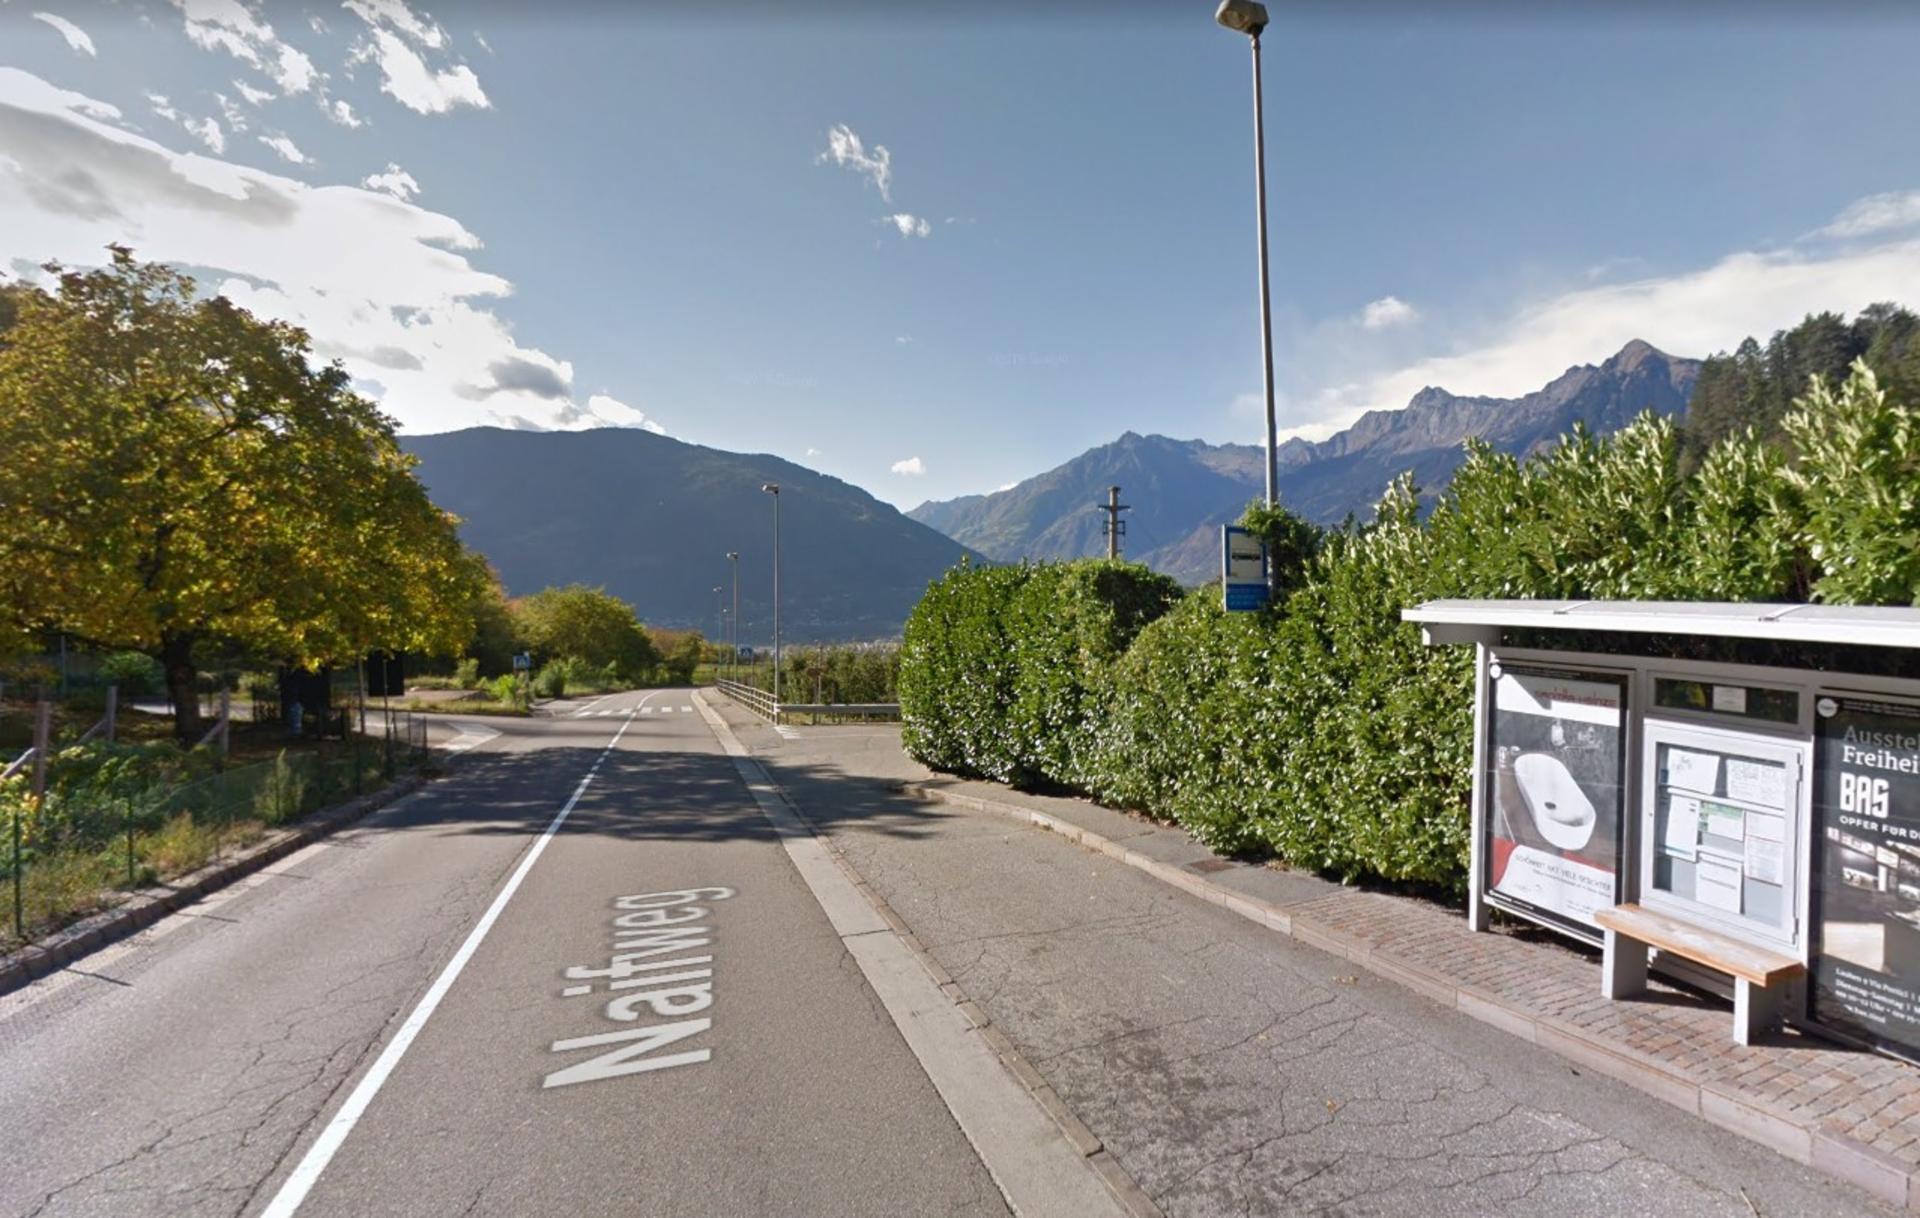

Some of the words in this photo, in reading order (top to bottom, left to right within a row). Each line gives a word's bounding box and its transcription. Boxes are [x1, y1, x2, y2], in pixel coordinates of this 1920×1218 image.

[1843, 745, 1919, 774] Freihei
[1840, 772, 1889, 818] BAS
[1839, 815, 1879, 831] OPFER
